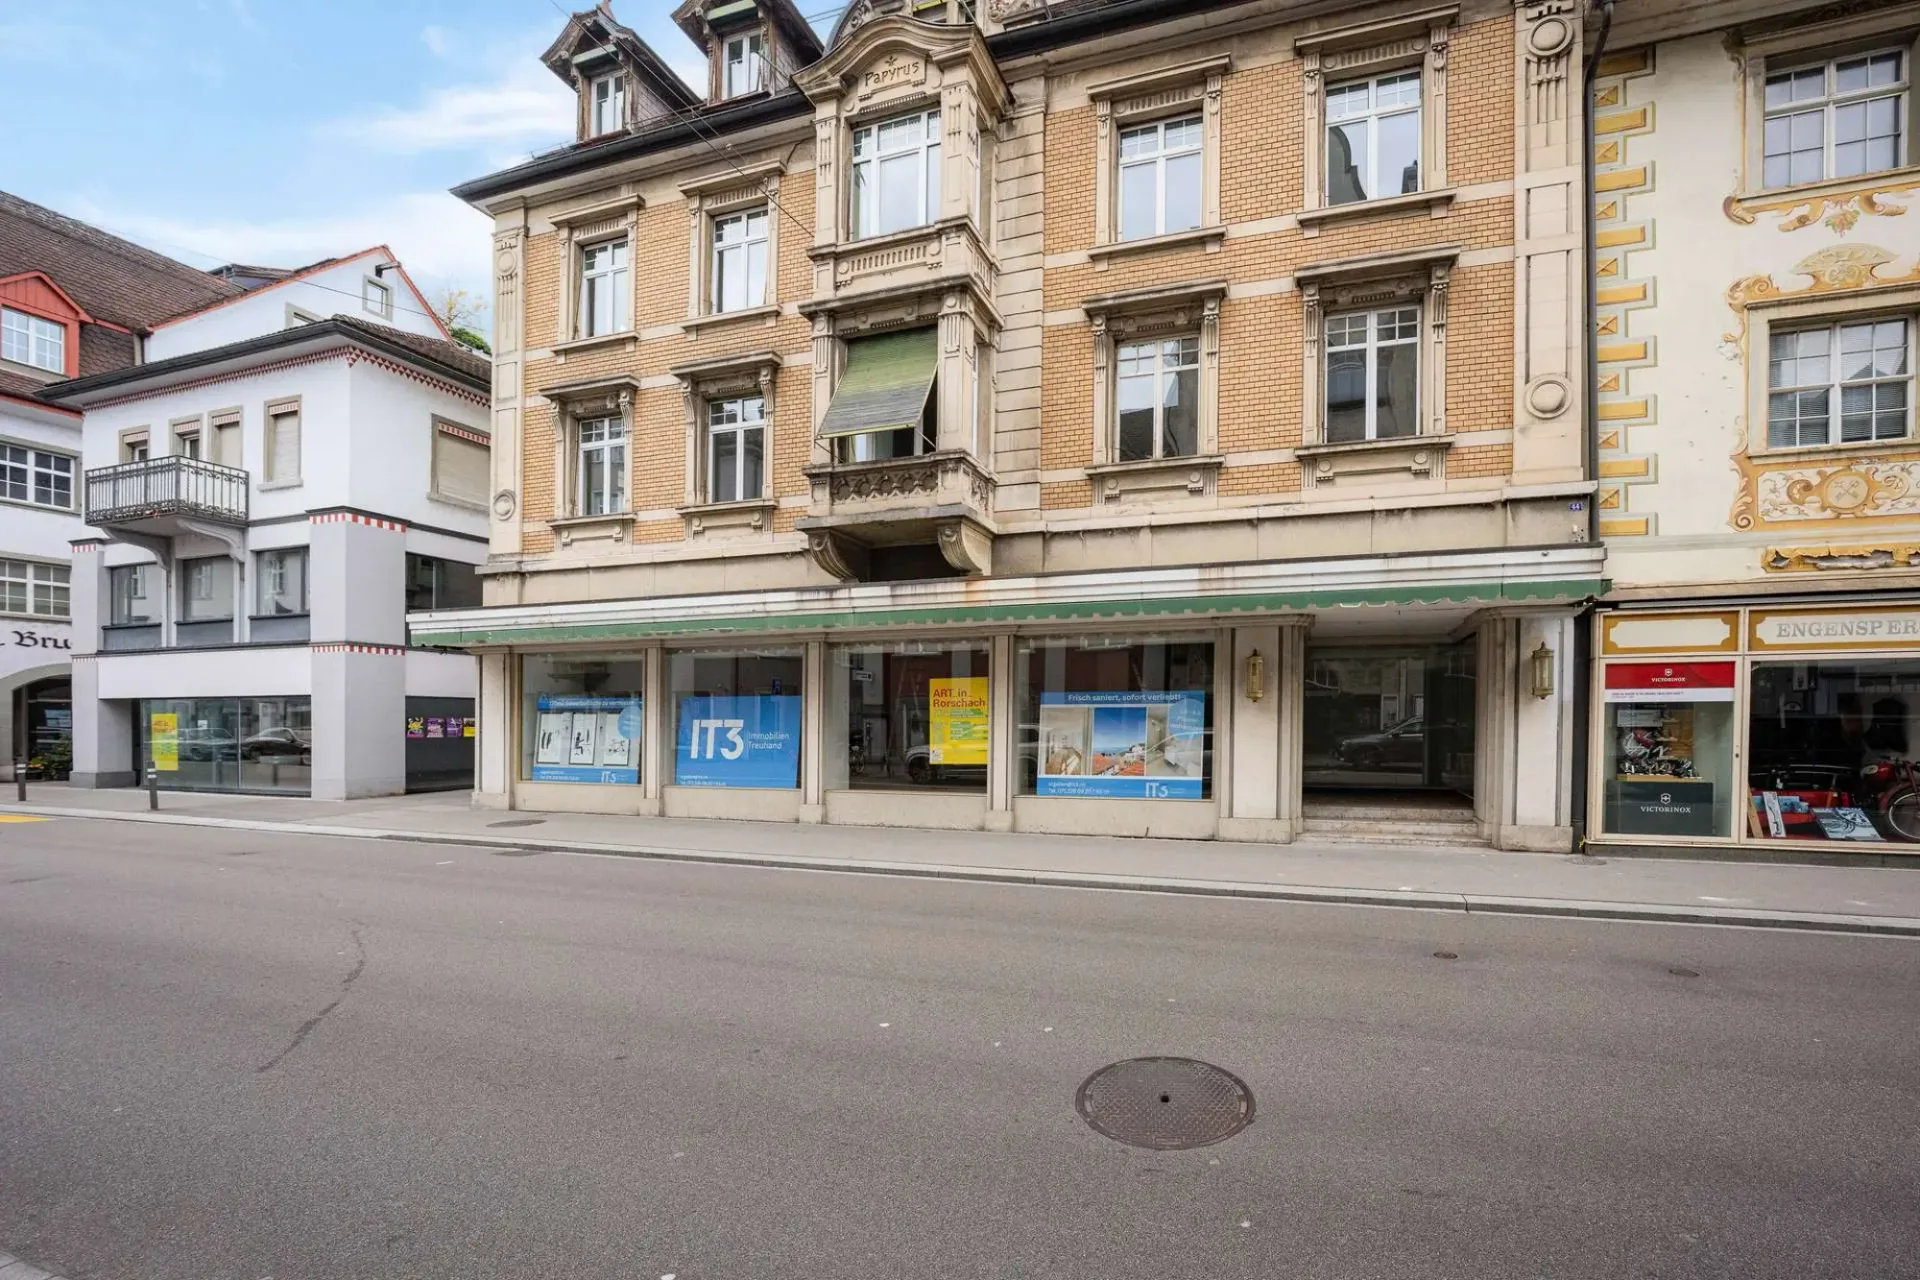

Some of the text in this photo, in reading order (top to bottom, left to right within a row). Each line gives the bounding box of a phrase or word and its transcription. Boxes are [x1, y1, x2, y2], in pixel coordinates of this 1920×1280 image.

[865, 61, 919, 87] Papyrus
[1776, 619, 1920, 638] ENGENSPER
[932, 698, 986, 708] Rorschach
[690, 719, 744, 760] IT3
[748, 732, 790, 740] Immobilien
[748, 741, 782, 749] Treuhand
[1640, 805, 1691, 813] VICTORINOX
